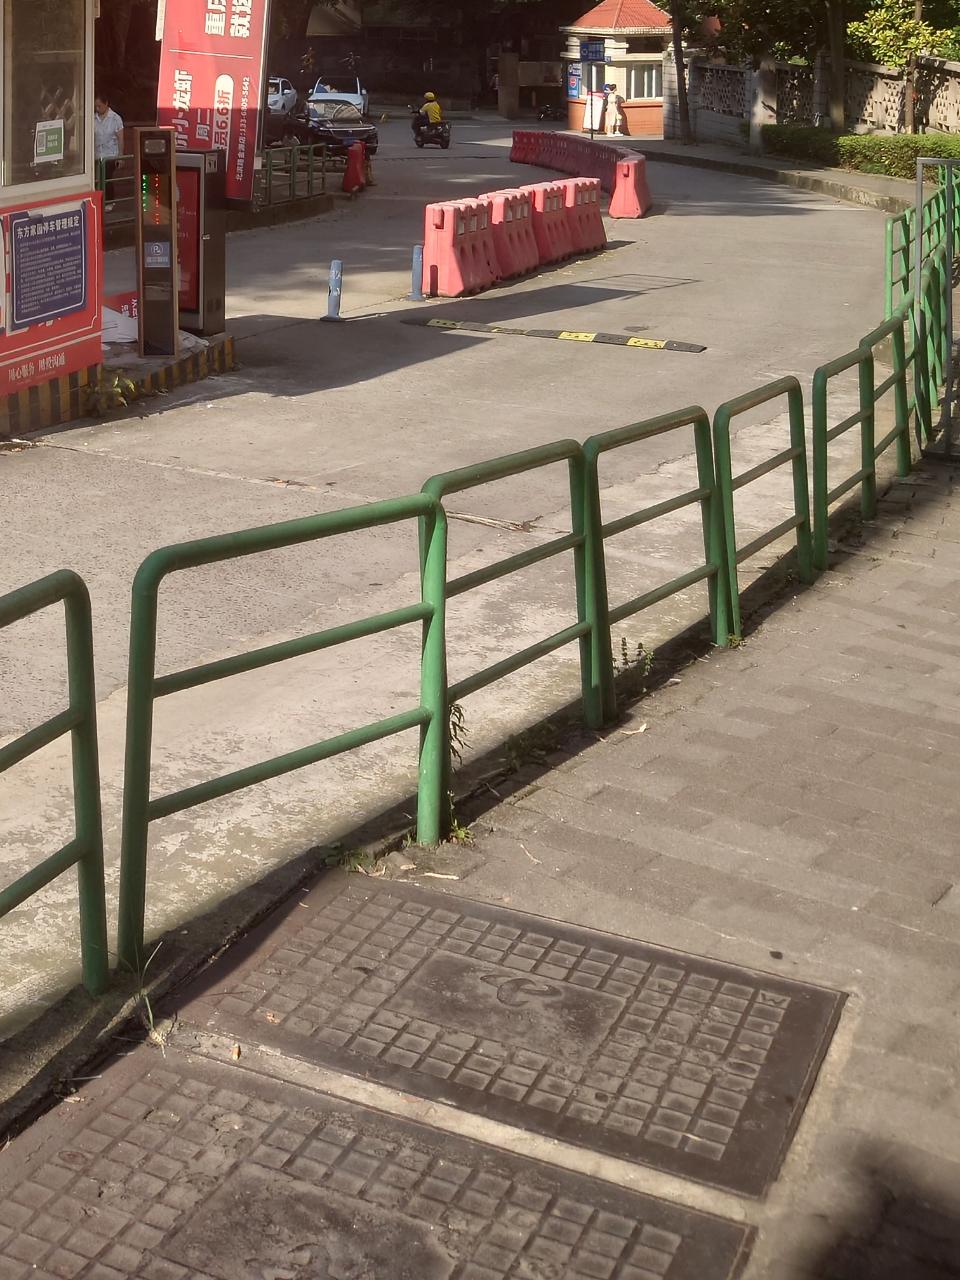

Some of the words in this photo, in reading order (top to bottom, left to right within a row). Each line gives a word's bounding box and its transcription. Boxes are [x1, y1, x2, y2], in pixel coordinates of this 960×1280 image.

[16, 216, 80, 238] 东方家园停车管理规定
